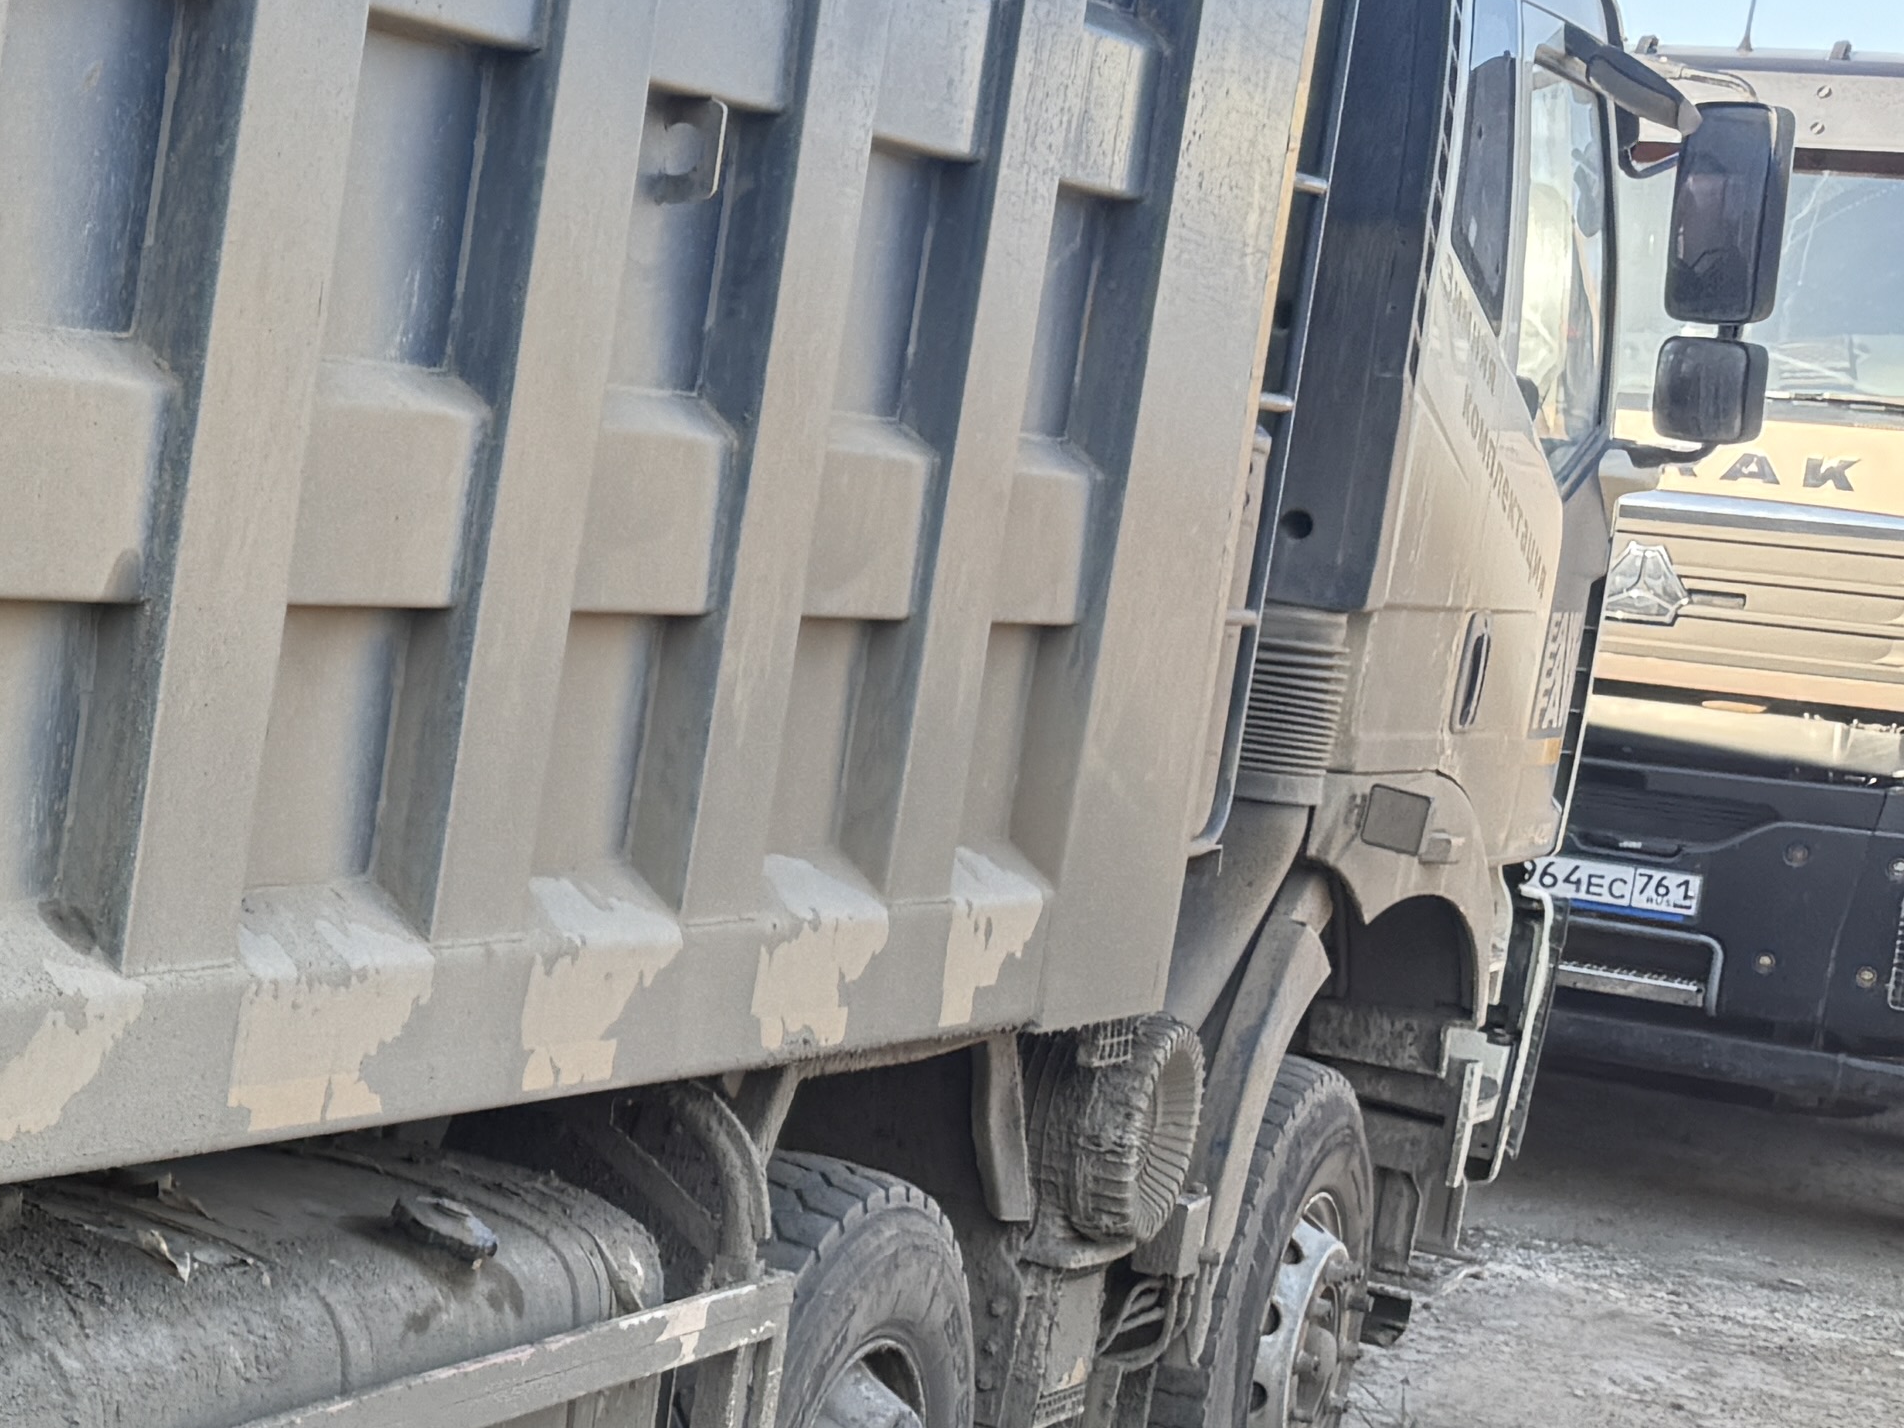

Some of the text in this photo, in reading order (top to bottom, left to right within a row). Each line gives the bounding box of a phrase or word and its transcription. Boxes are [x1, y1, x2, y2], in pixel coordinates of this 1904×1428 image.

[1439, 251, 1496, 397] Зимняя
[1462, 383, 1546, 600] комплектация
[1677, 452, 1862, 492] AK
[1638, 872, 1695, 901] 761
